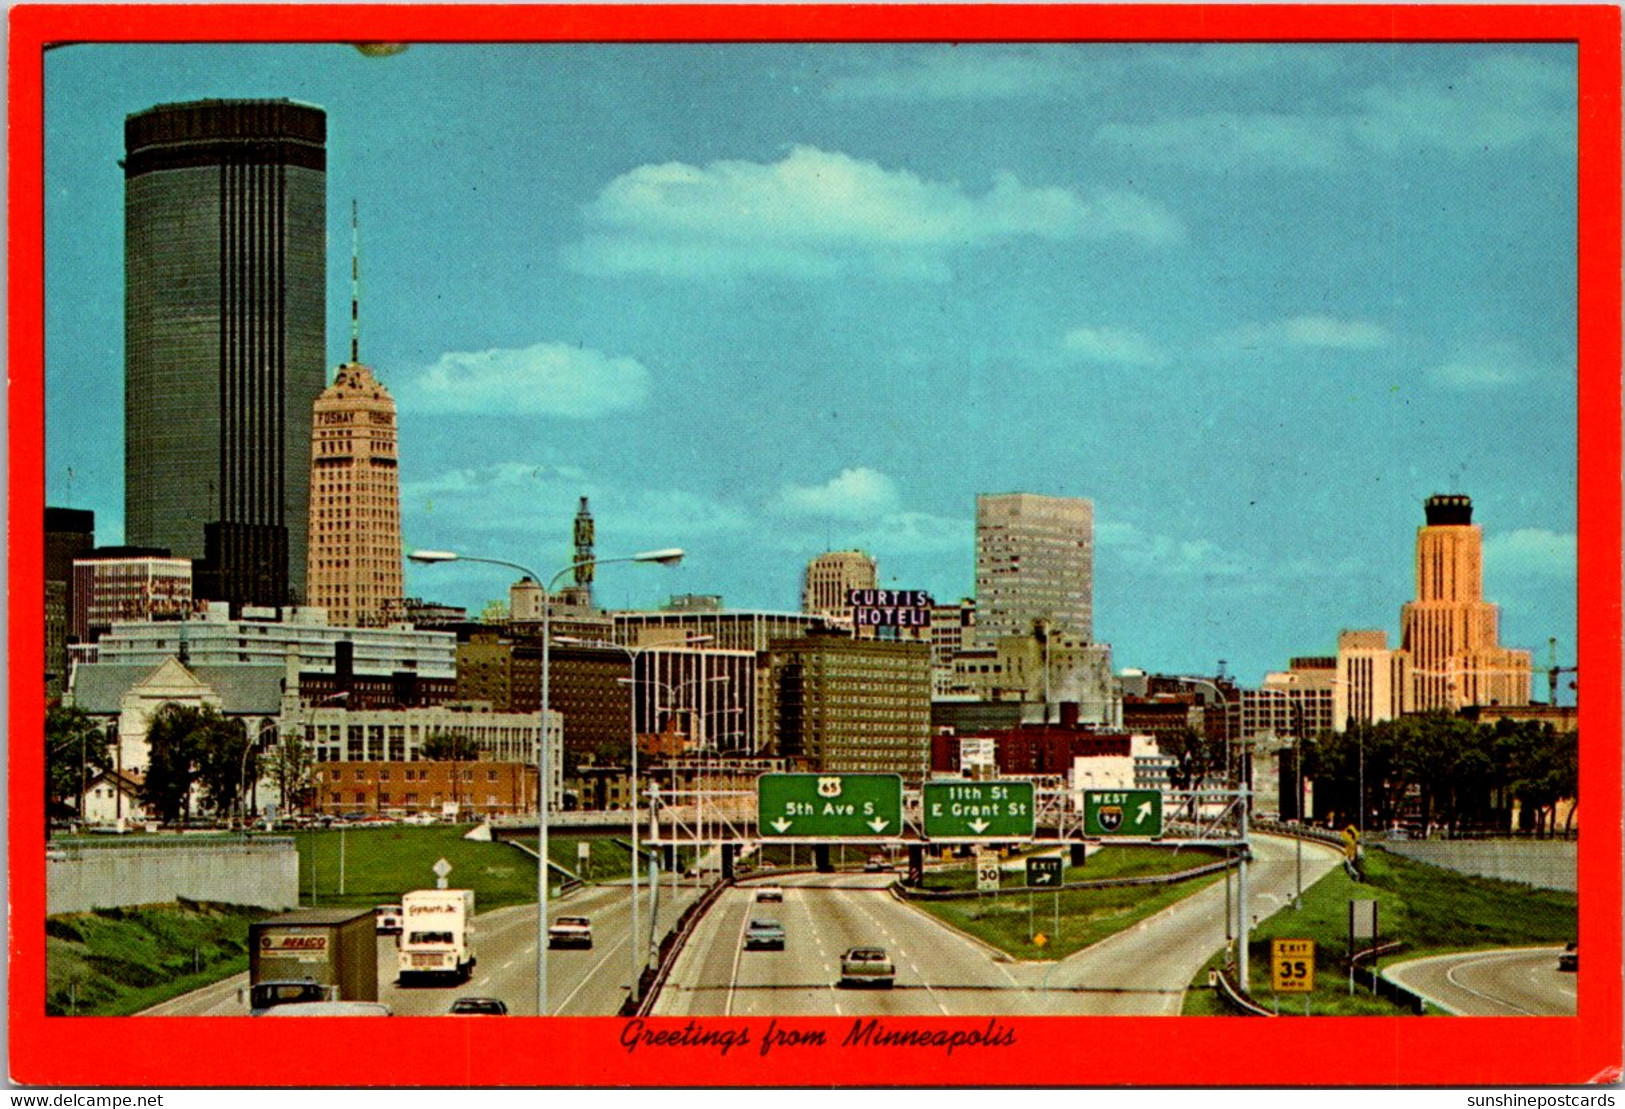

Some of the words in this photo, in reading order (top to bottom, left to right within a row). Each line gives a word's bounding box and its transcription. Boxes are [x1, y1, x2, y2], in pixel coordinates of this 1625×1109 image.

[318, 412, 355, 425] FOSHAY
[851, 590, 926, 606] CURTIS
[821, 782, 838, 793] 65
[949, 786, 982, 800] 11th
[991, 786, 1008, 800] St
[1092, 793, 1128, 804] WEST
[786, 802, 814, 815] 5th
[822, 802, 854, 815] Ave
[863, 802, 874, 815] S
[932, 803, 943, 816] E
[952, 803, 999, 816] Grant
[1008, 802, 1026, 816] St
[1031, 862, 1058, 871] EXIT
[979, 869, 998, 881] 30
[1280, 944, 1307, 952] EXIT
[1280, 961, 1306, 979] 35
[620, 1019, 750, 1056] Greetings
[760, 1019, 827, 1056] from
[841, 1018, 1016, 1056] Minneapolis
